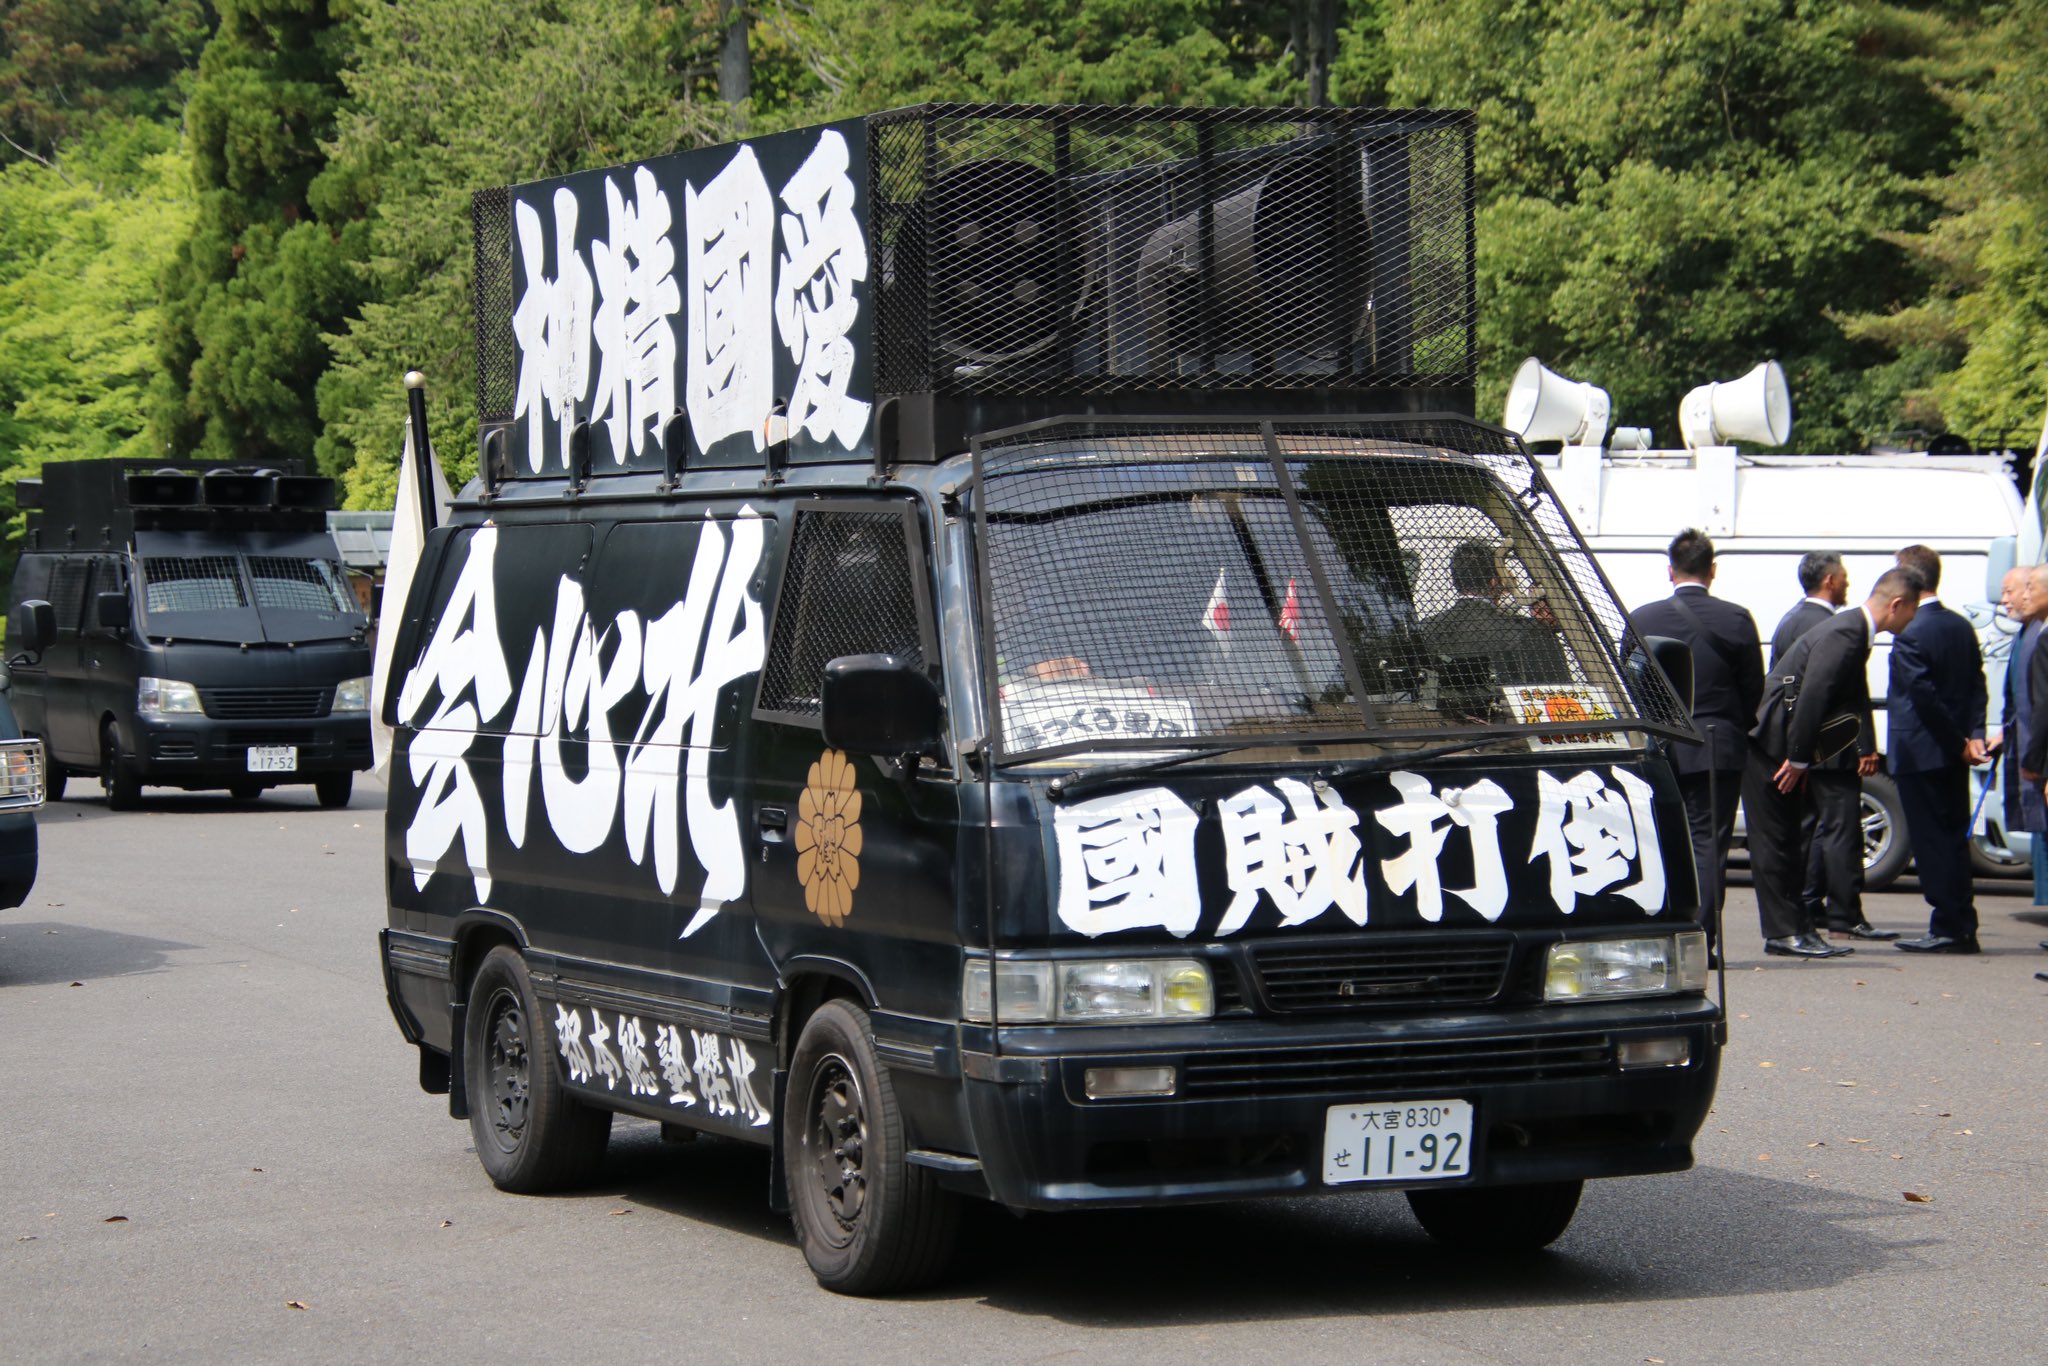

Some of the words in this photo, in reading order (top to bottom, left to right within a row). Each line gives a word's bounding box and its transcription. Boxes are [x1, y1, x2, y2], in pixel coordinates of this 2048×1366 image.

[260, 757, 294, 769] 17-52
[1055, 765, 1666, 938] 國賊打倒
[1362, 1109, 1401, 1130] 大宮
[1406, 1107, 1441, 1127] 830
[1334, 1148, 1352, 1168] せ
[1363, 1132, 1462, 1175] 11-92
